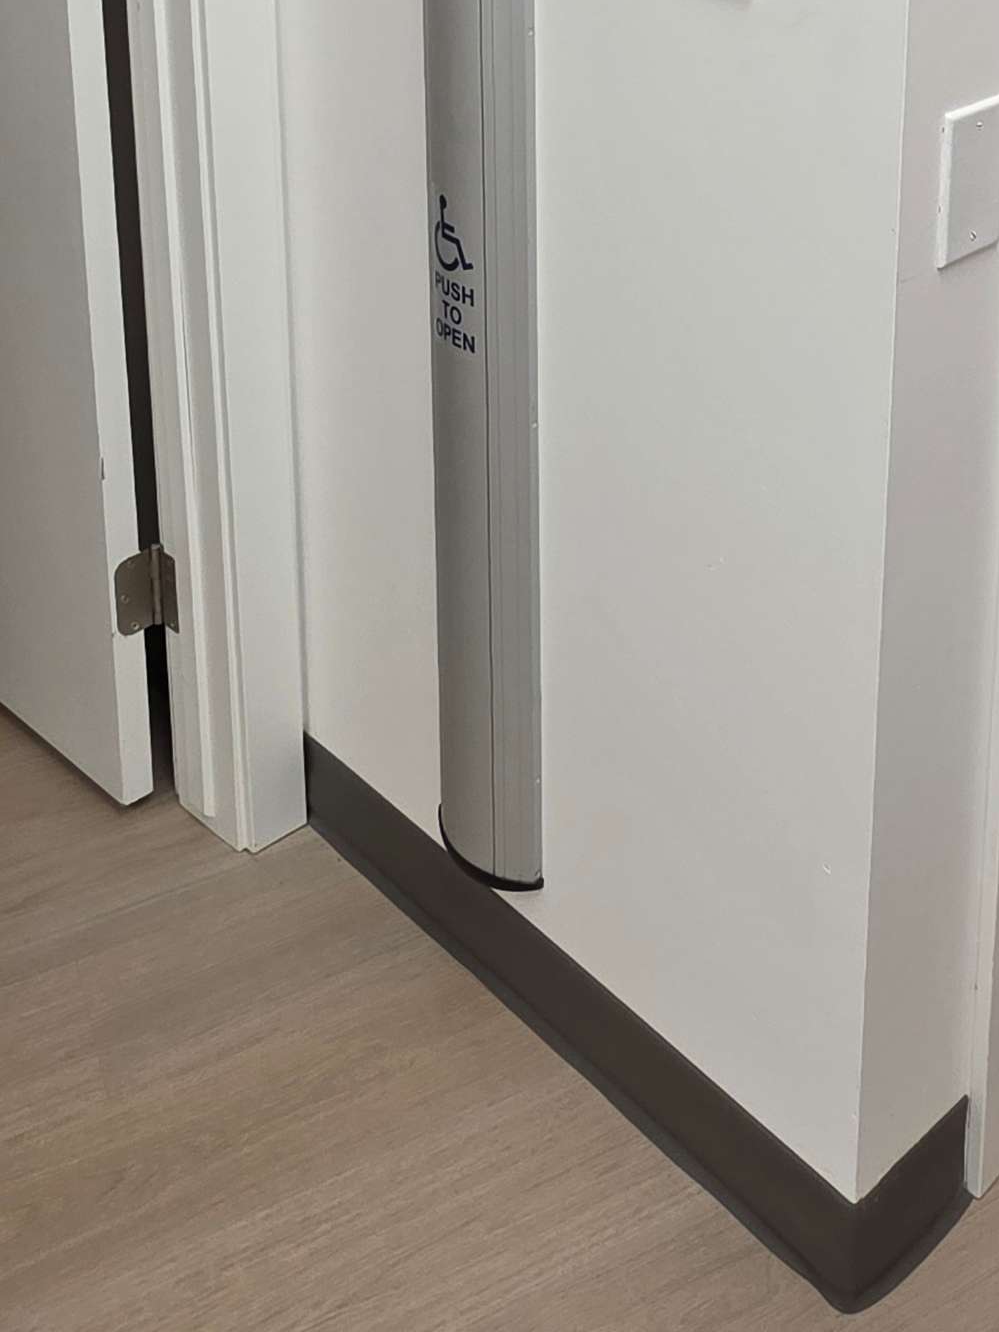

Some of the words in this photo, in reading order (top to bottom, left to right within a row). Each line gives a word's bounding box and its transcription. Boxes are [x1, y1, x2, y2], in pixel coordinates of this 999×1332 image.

[435, 271, 475, 307] PUSH
[441, 300, 462, 325] TO
[435, 318, 476, 354] OPEN
